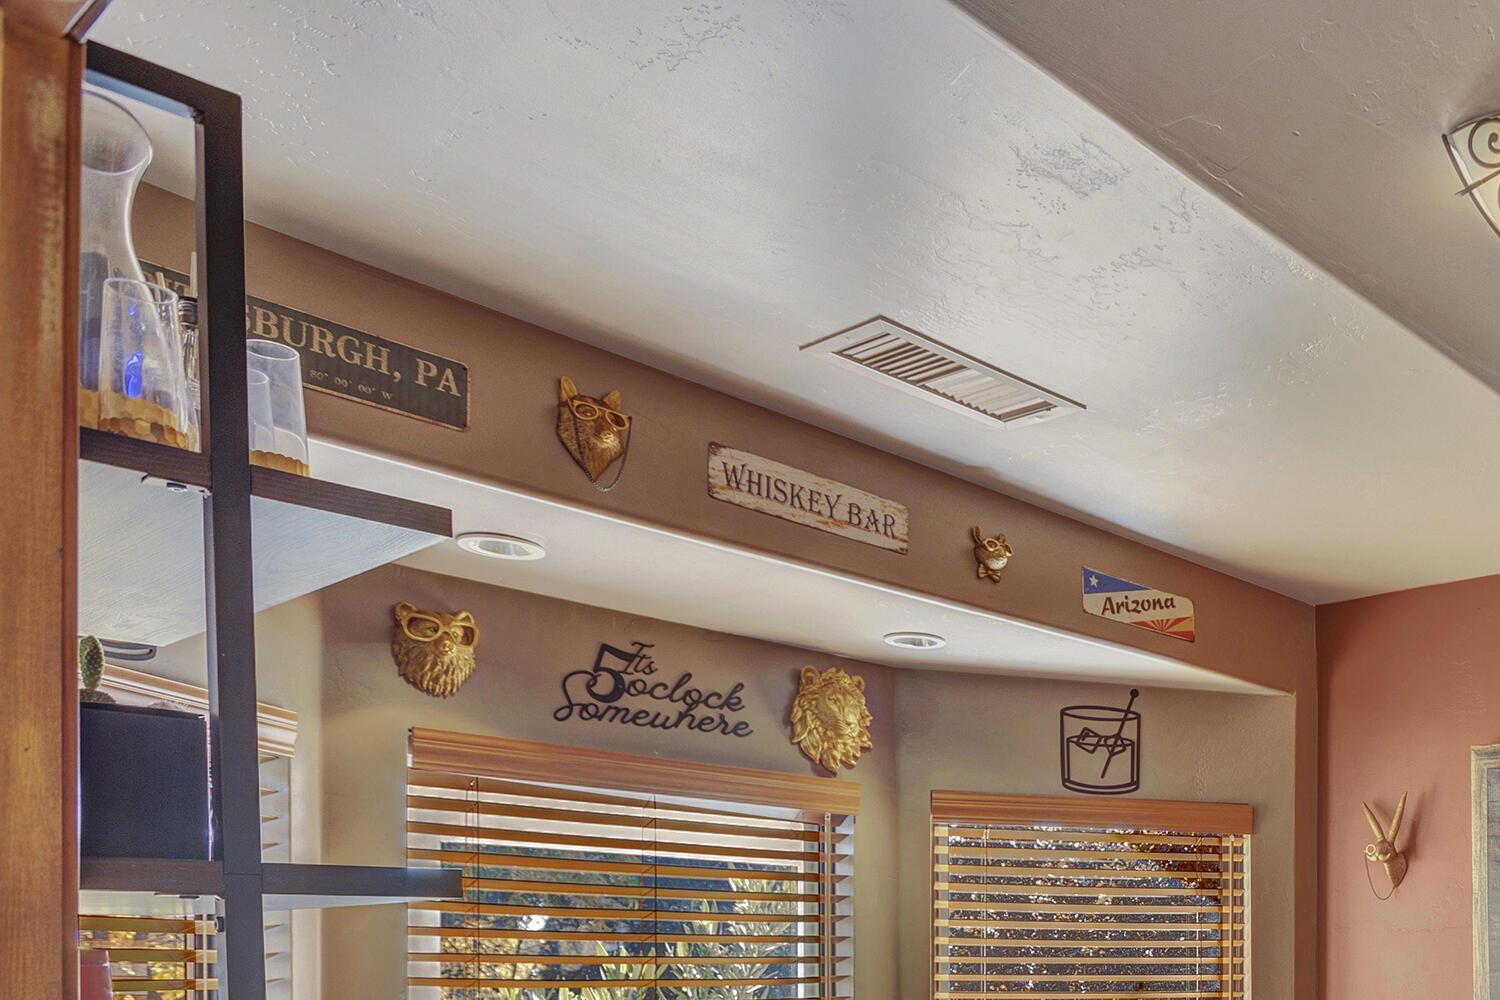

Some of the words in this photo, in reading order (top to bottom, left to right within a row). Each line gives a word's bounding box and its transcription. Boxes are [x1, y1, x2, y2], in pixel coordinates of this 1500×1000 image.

[381, 390, 393, 401] W
[415, 357, 462, 397] PA
[721, 459, 844, 520] WHISKEY
[847, 502, 896, 540] BAR
[1101, 595, 1176, 615] Arizona
[553, 669, 754, 738] Somewhere
[586, 643, 634, 703] 5
[624, 672, 746, 713] oclock
